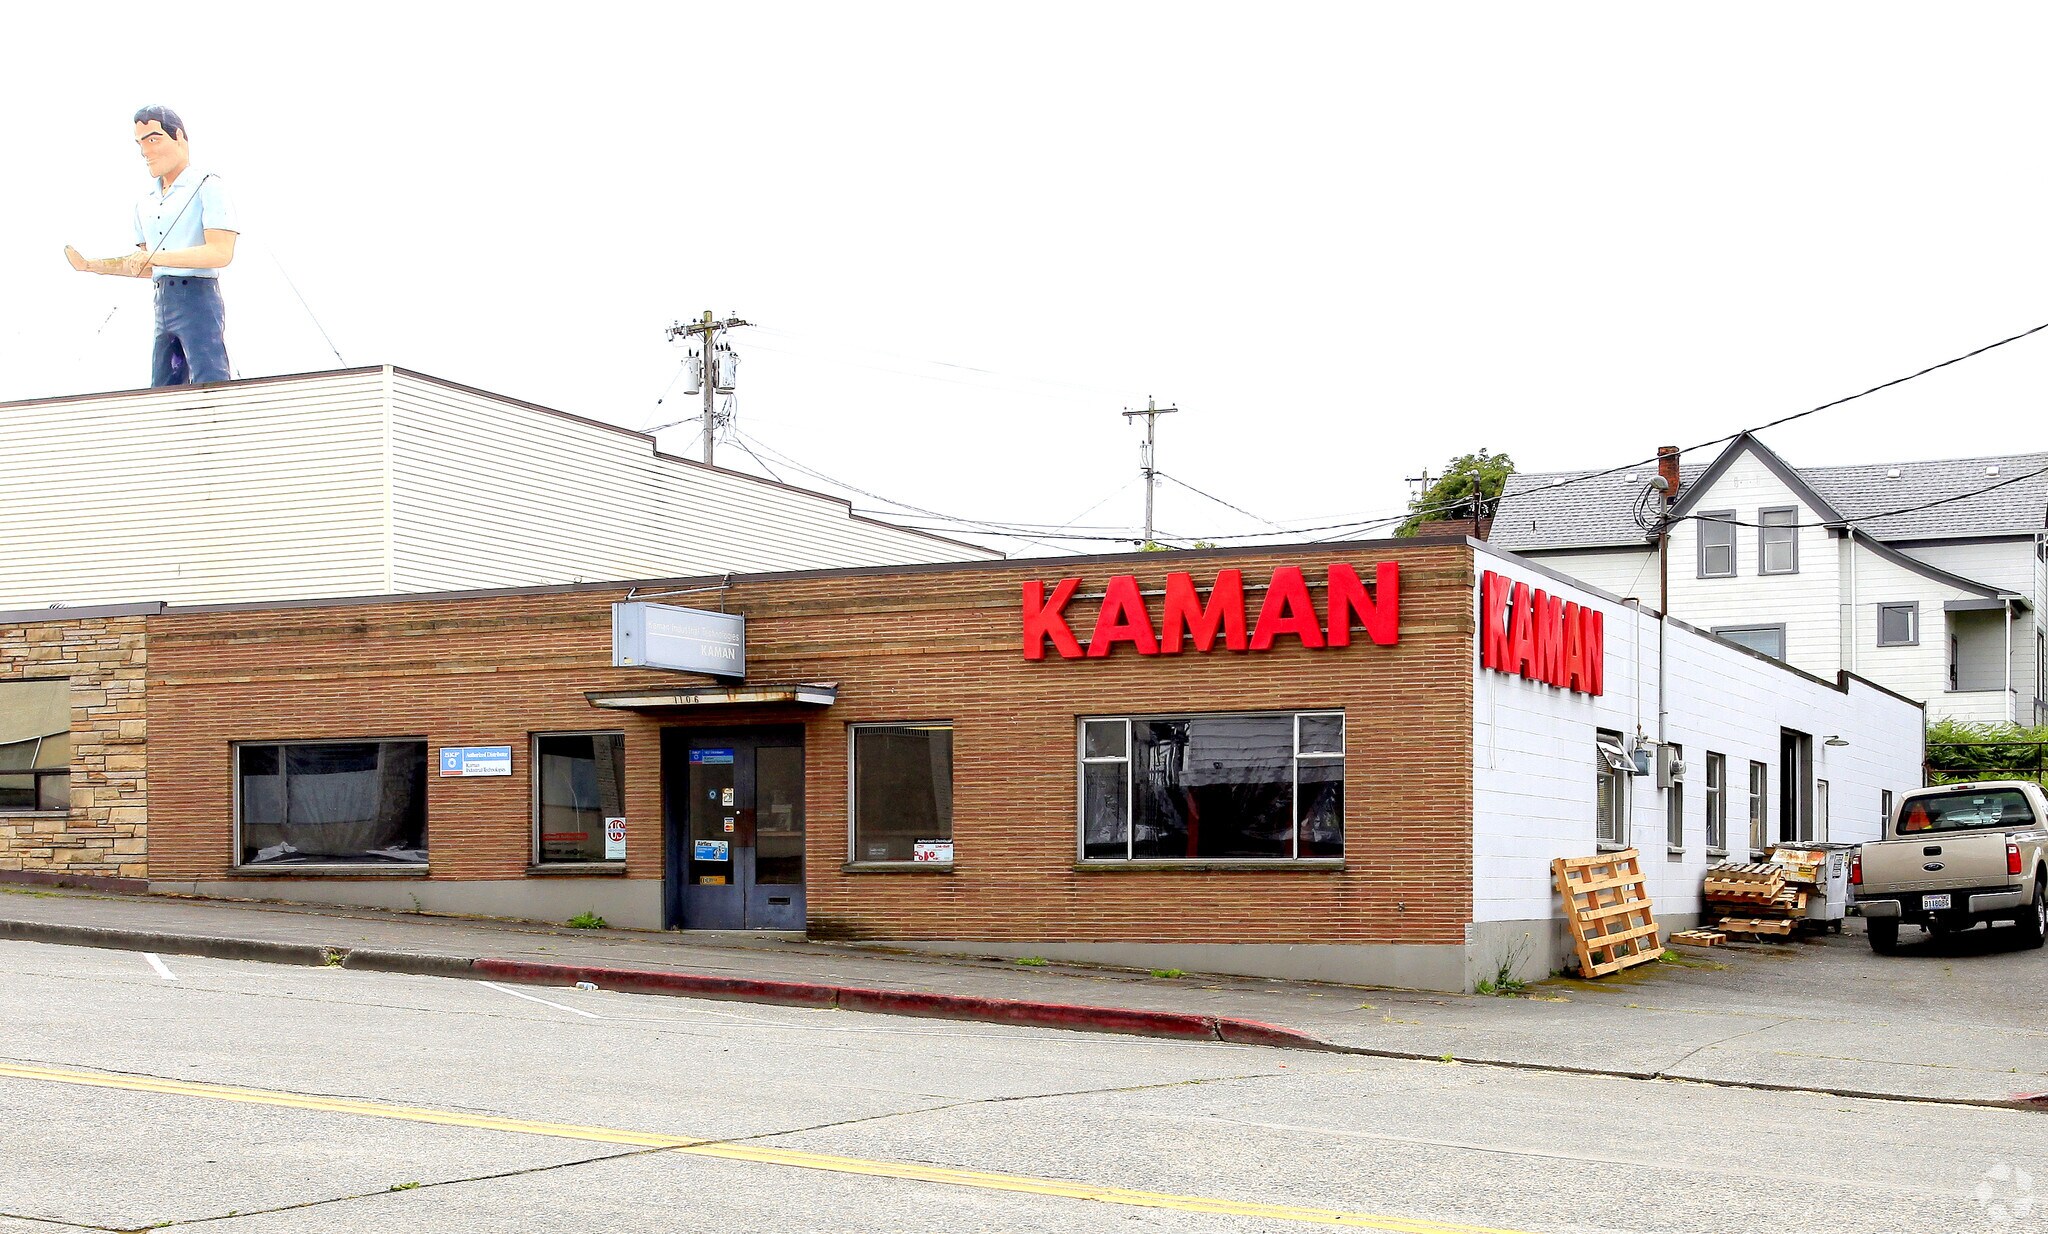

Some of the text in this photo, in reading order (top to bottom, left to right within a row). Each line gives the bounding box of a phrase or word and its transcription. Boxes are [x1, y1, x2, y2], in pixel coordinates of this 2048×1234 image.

[1022, 561, 1400, 661] KAMAN
[1482, 570, 1604, 696] KAMAN
[701, 644, 735, 660] KAMAN
[673, 695, 699, 705] 1106
[1889, 878, 1982, 891] SUPER DUTY
